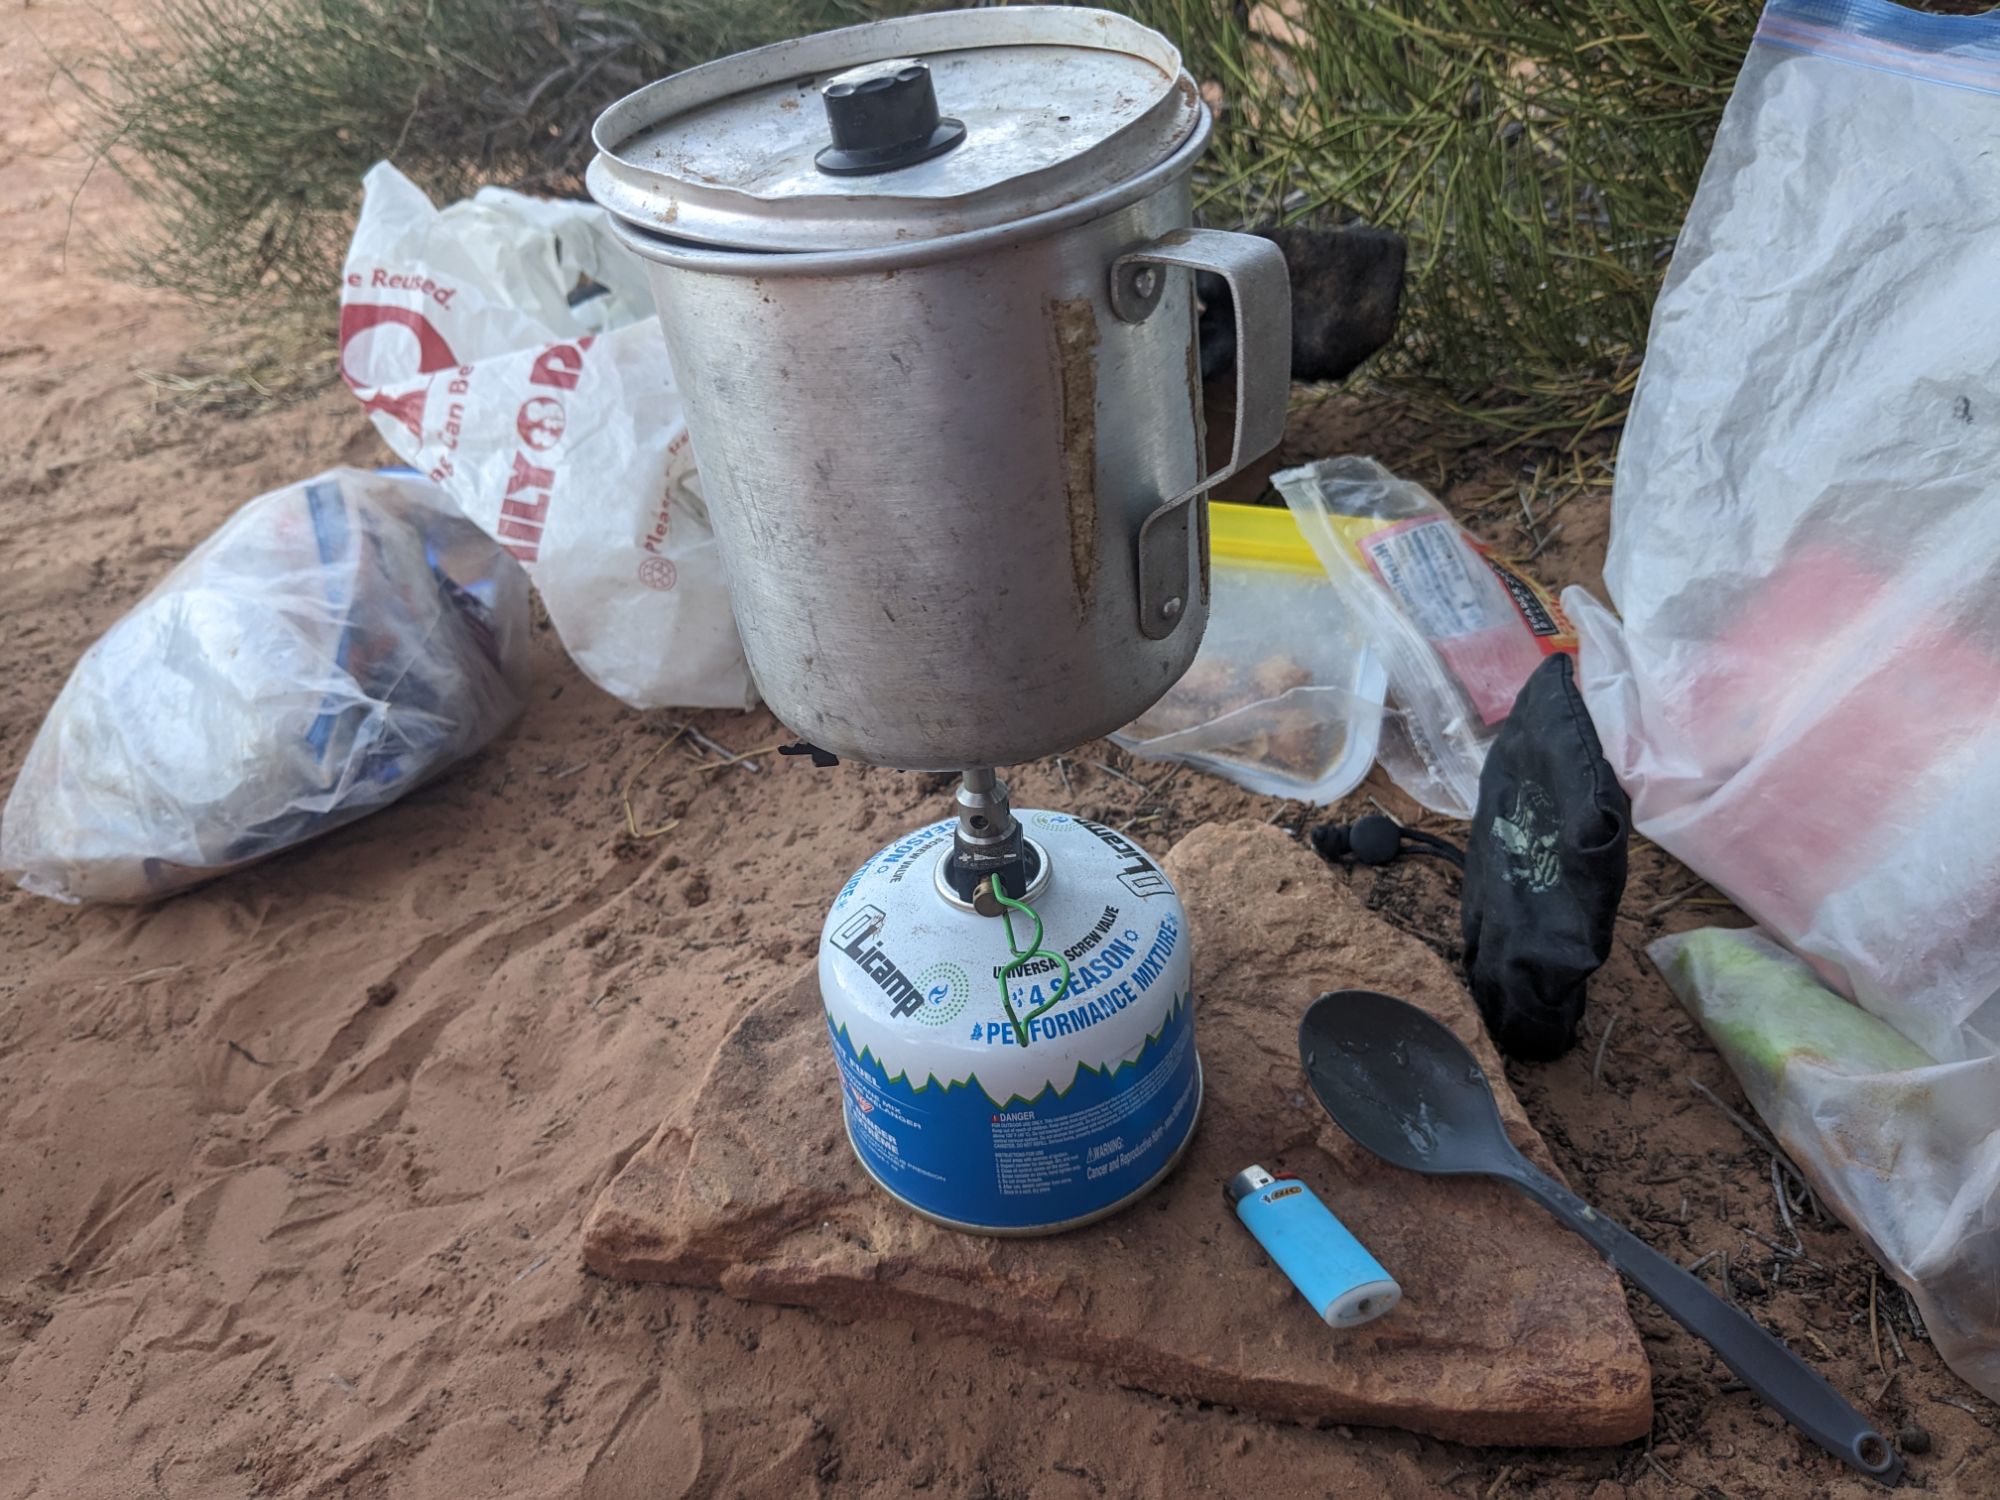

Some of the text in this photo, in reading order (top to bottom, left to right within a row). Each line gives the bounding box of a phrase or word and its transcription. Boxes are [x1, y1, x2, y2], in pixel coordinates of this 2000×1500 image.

[342, 267, 457, 310] e Reused.
[449, 364, 474, 395] Be
[498, 450, 555, 563] ILY
[644, 487, 673, 554] Plea
[993, 905, 1120, 980] UIVERSA SCREW VALVE
[1029, 938, 1136, 1009] 4 SEASON
[1131, 920, 1179, 993] MIXTURE
[999, 1111, 1036, 1122] DANGER
[1086, 1163, 1108, 1181] Cancer
